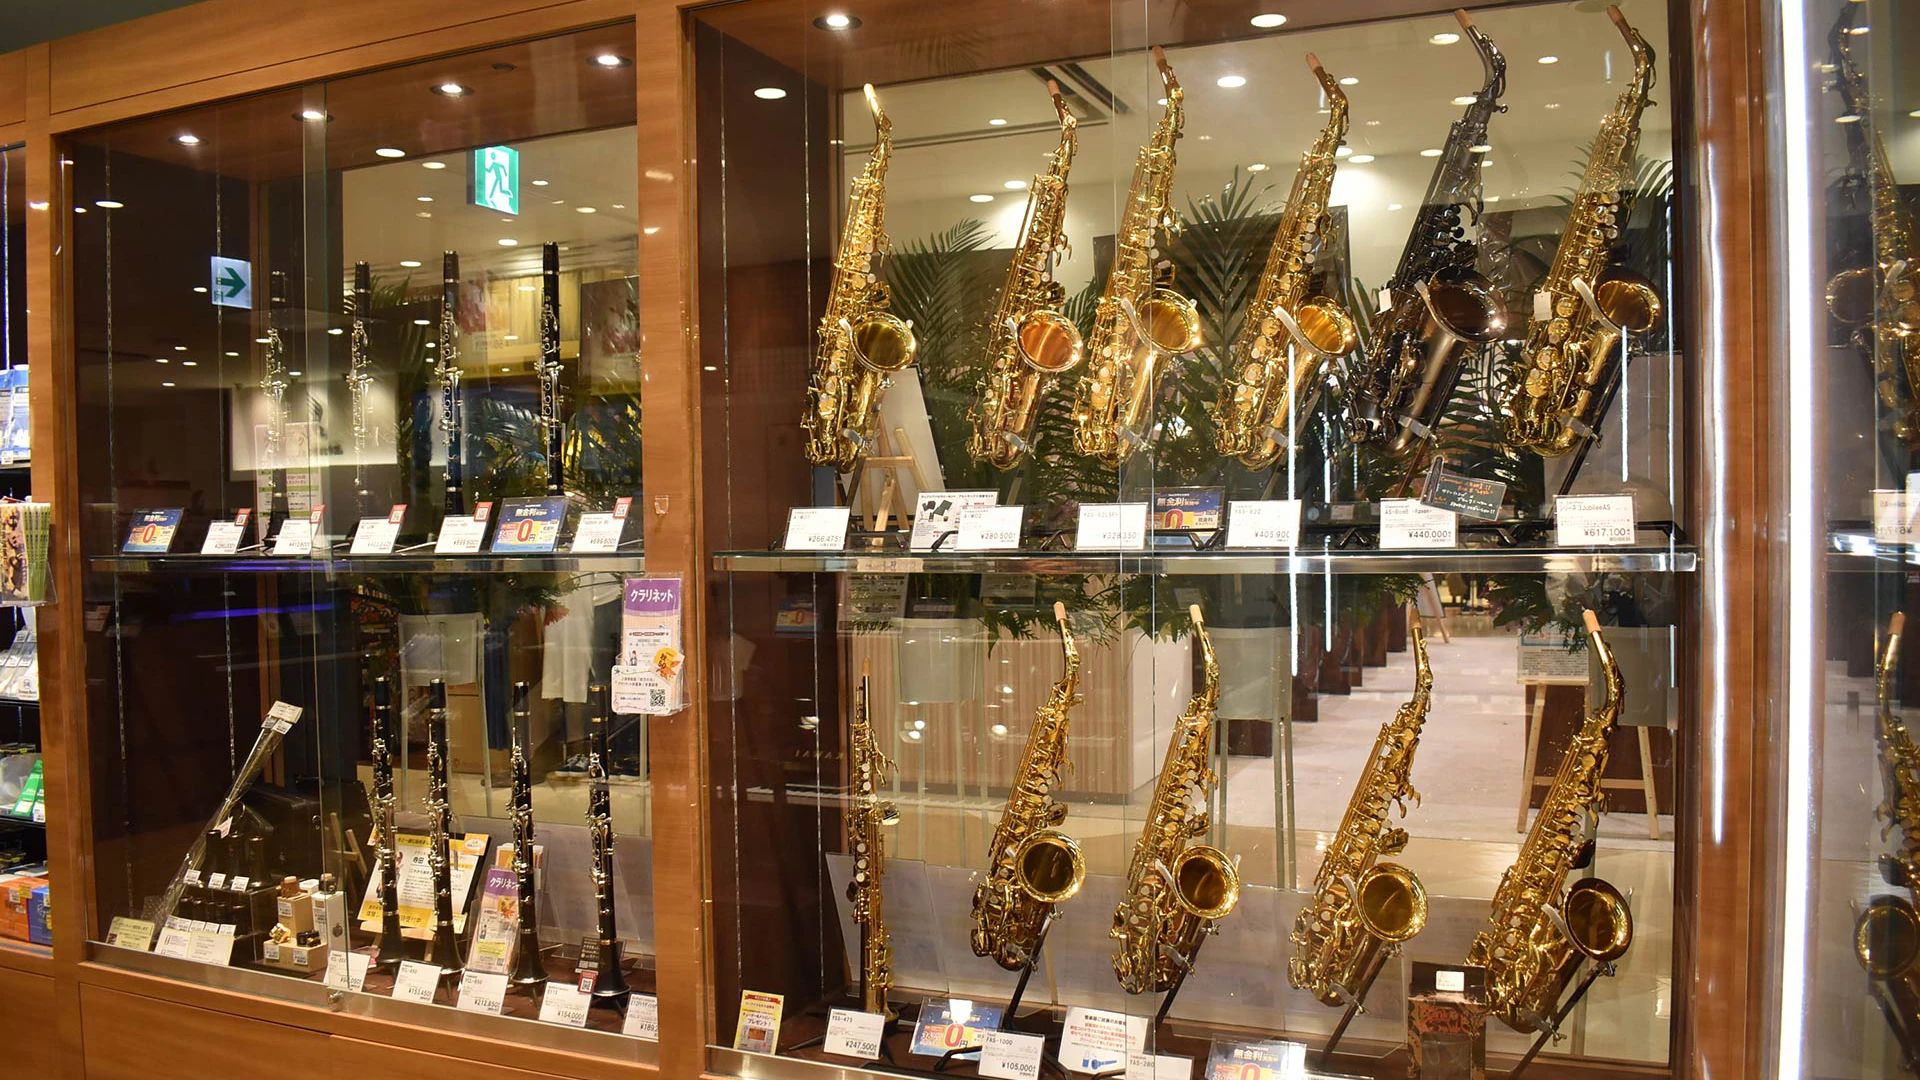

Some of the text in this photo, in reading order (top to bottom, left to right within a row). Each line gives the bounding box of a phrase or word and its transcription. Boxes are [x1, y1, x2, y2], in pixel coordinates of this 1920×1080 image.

[630, 588, 674, 604] クラリネット
[489, 876, 520, 891] クラリネッ
